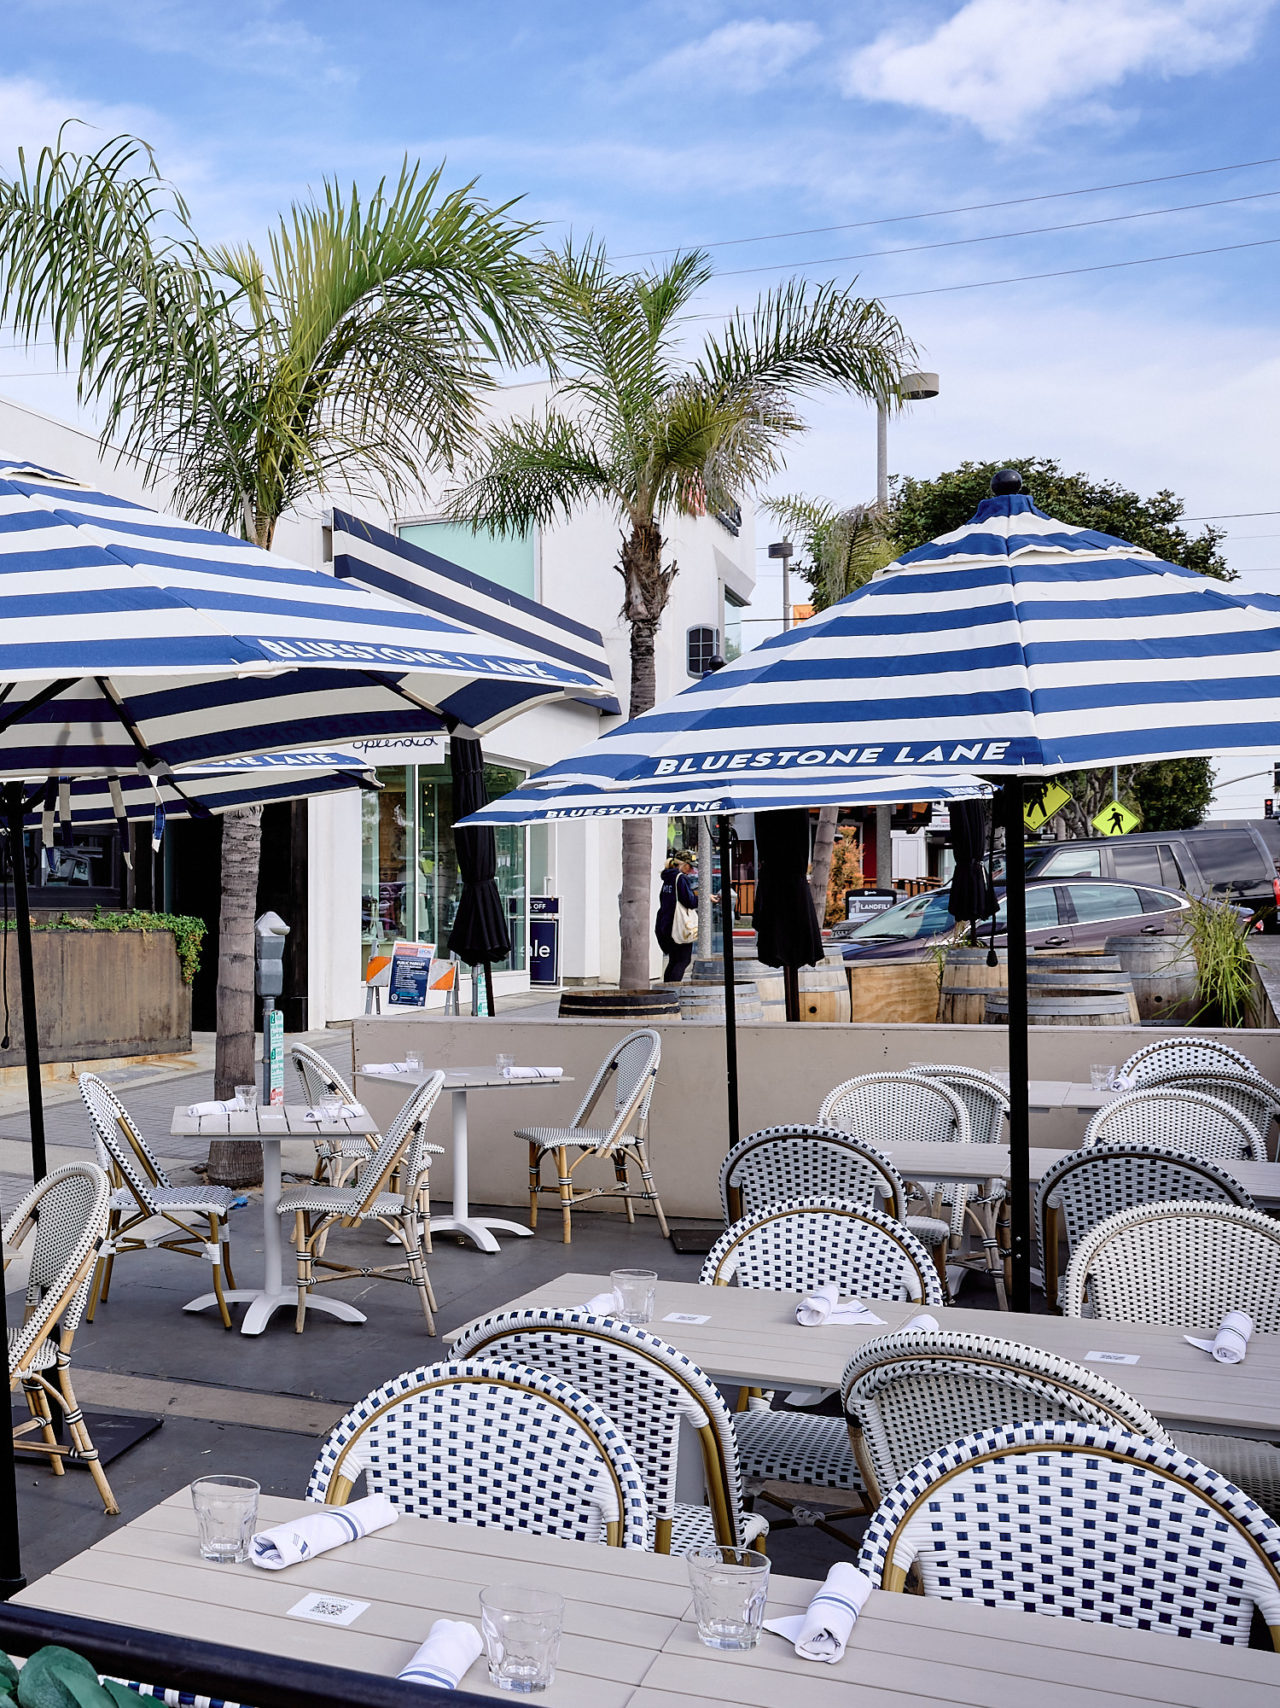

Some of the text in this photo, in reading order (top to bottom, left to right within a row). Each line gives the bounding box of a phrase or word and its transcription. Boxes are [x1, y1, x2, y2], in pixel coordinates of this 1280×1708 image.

[258, 639, 558, 680] BLUESTONE LANE
[266, 753, 339, 766] LANE
[654, 741, 1011, 776] BLUESTONE LANE
[545, 800, 722, 819] BLUESTONE LANE
